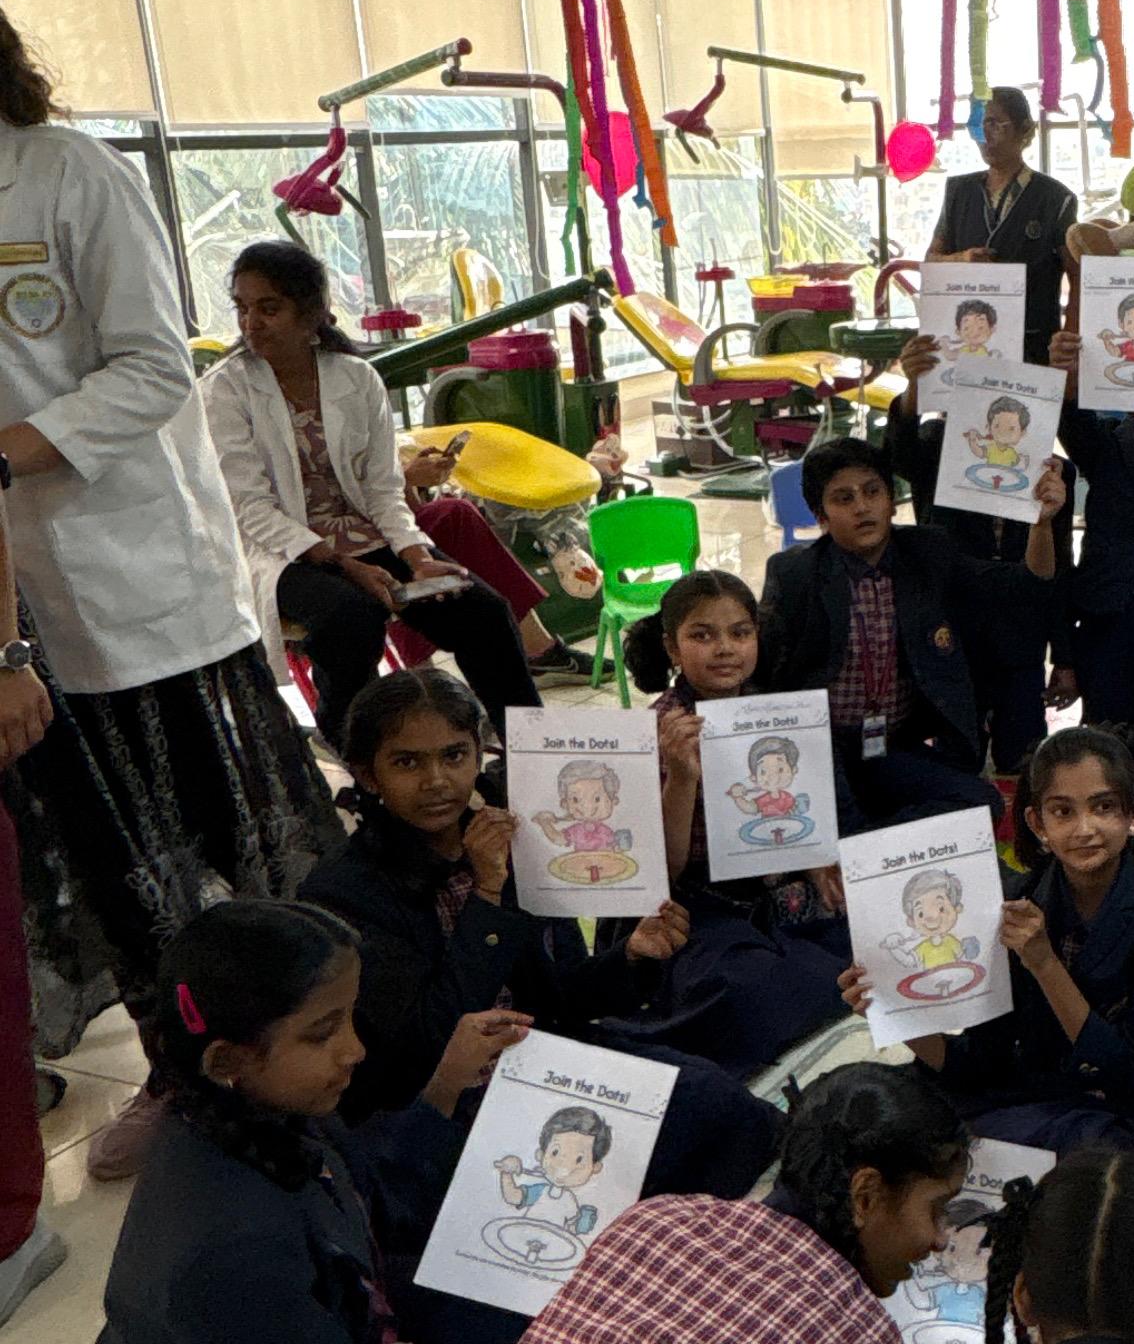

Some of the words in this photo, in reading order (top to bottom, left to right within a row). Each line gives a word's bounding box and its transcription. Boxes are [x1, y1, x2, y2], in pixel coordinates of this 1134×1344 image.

[543, 738, 566, 749] Join
[569, 738, 586, 749] the
[589, 738, 619, 749] Dots!
[882, 854, 906, 870] Join
[909, 850, 925, 863] the
[928, 843, 958, 857] Dots!
[543, 1071, 572, 1088] Join
[574, 1078, 594, 1094] the
[597, 1084, 630, 1105] Dots!
[980, 1174, 1003, 1189] Dot
